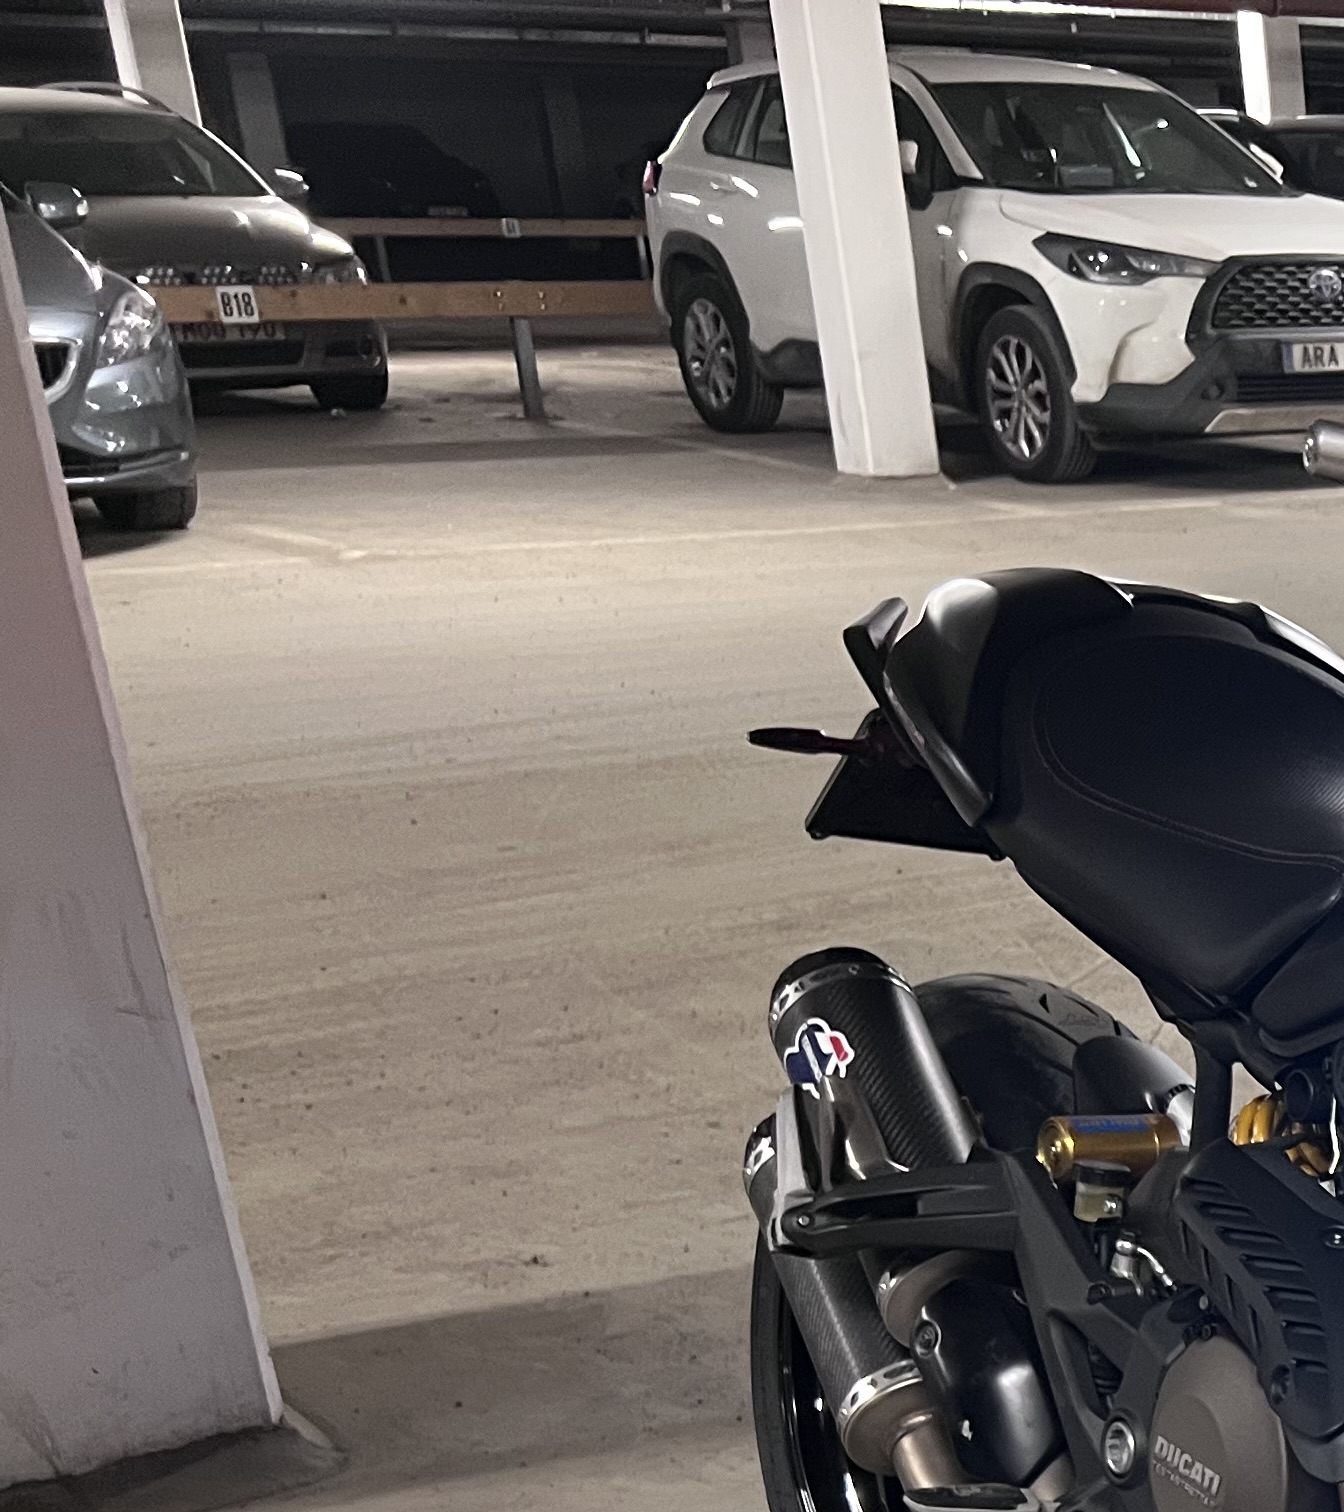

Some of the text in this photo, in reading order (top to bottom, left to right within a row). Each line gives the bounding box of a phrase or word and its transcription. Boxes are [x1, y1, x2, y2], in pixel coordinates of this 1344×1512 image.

[221, 292, 255, 317] B18
[1302, 345, 1340, 368] ARA
[1154, 1435, 1221, 1496] DUCATI
